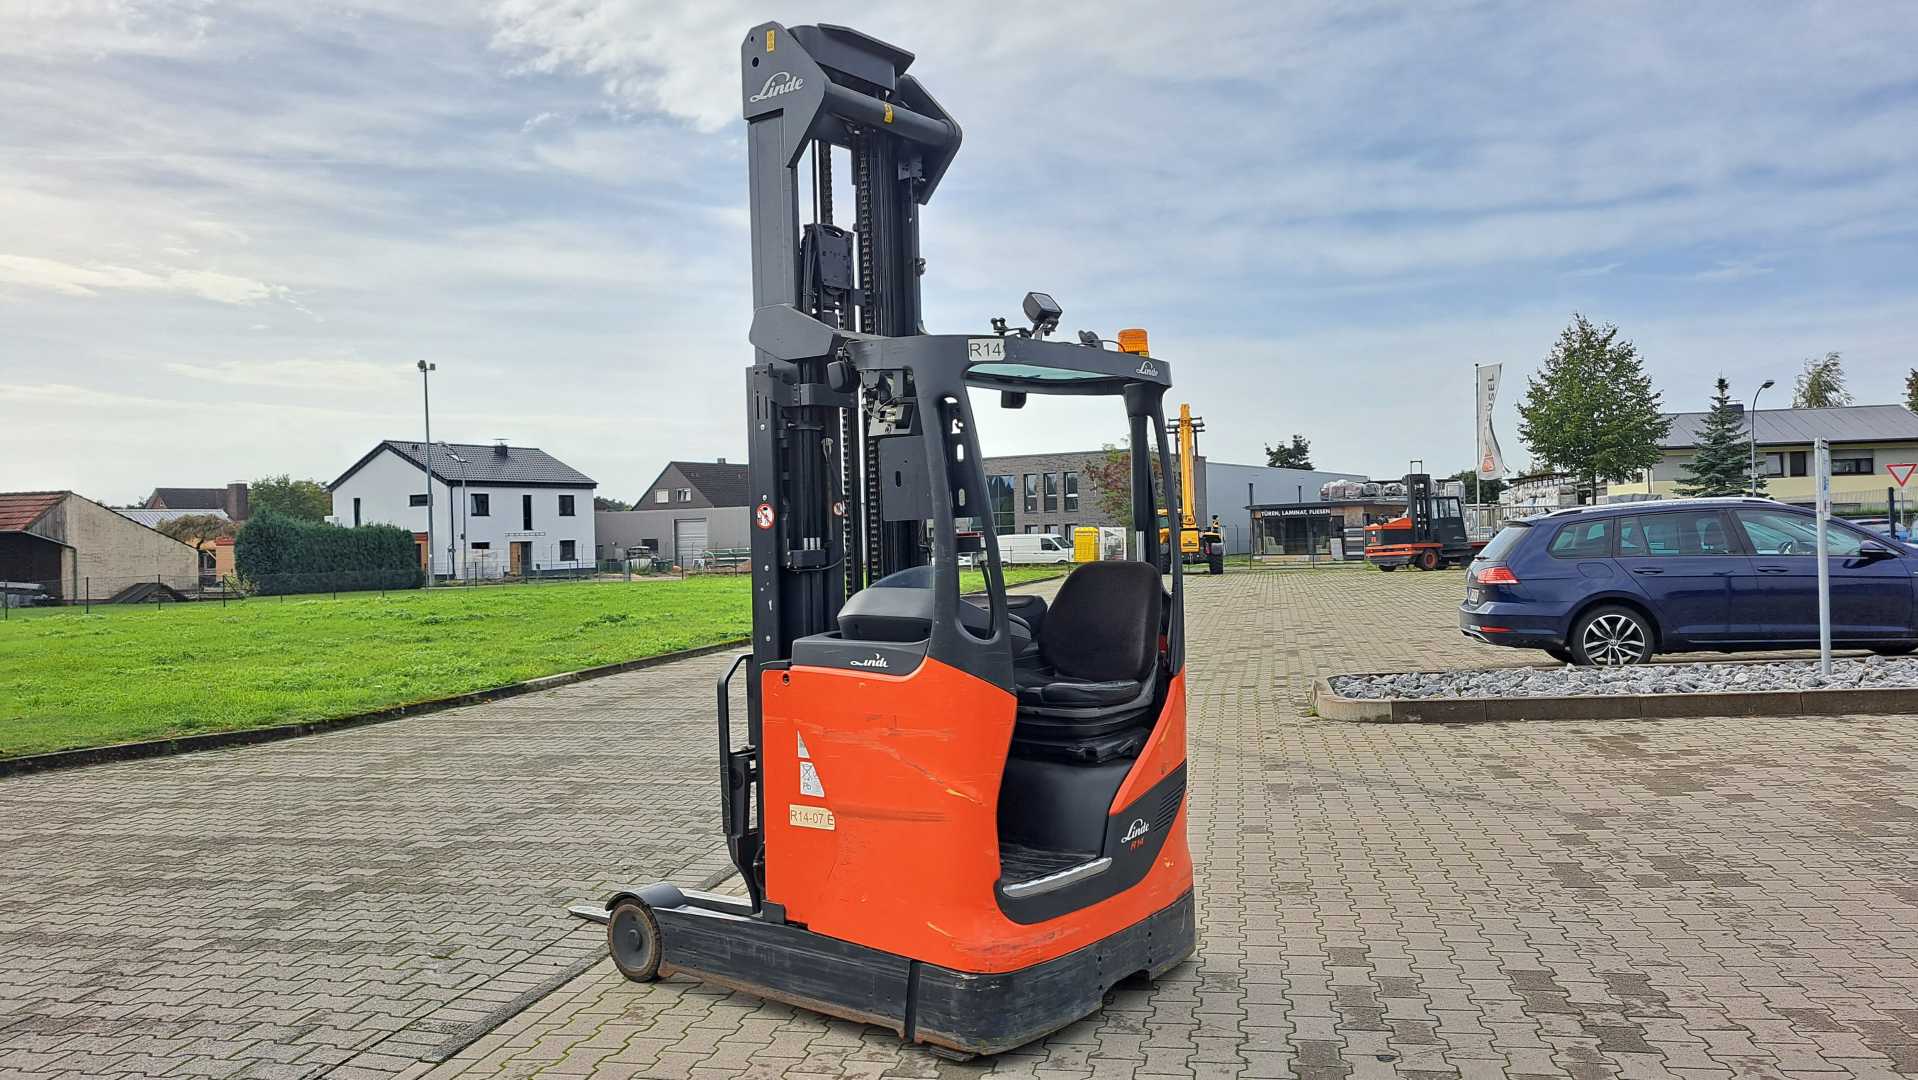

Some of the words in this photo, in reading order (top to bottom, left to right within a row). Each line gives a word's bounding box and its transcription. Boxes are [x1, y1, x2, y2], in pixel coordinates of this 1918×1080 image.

[750, 72, 804, 103] Linde
[970, 342, 1001, 357] R14
[1136, 360, 1159, 377] Linde
[791, 809, 824, 823] R14-07
[827, 814, 834, 826] E
[1121, 818, 1149, 843] Linde
